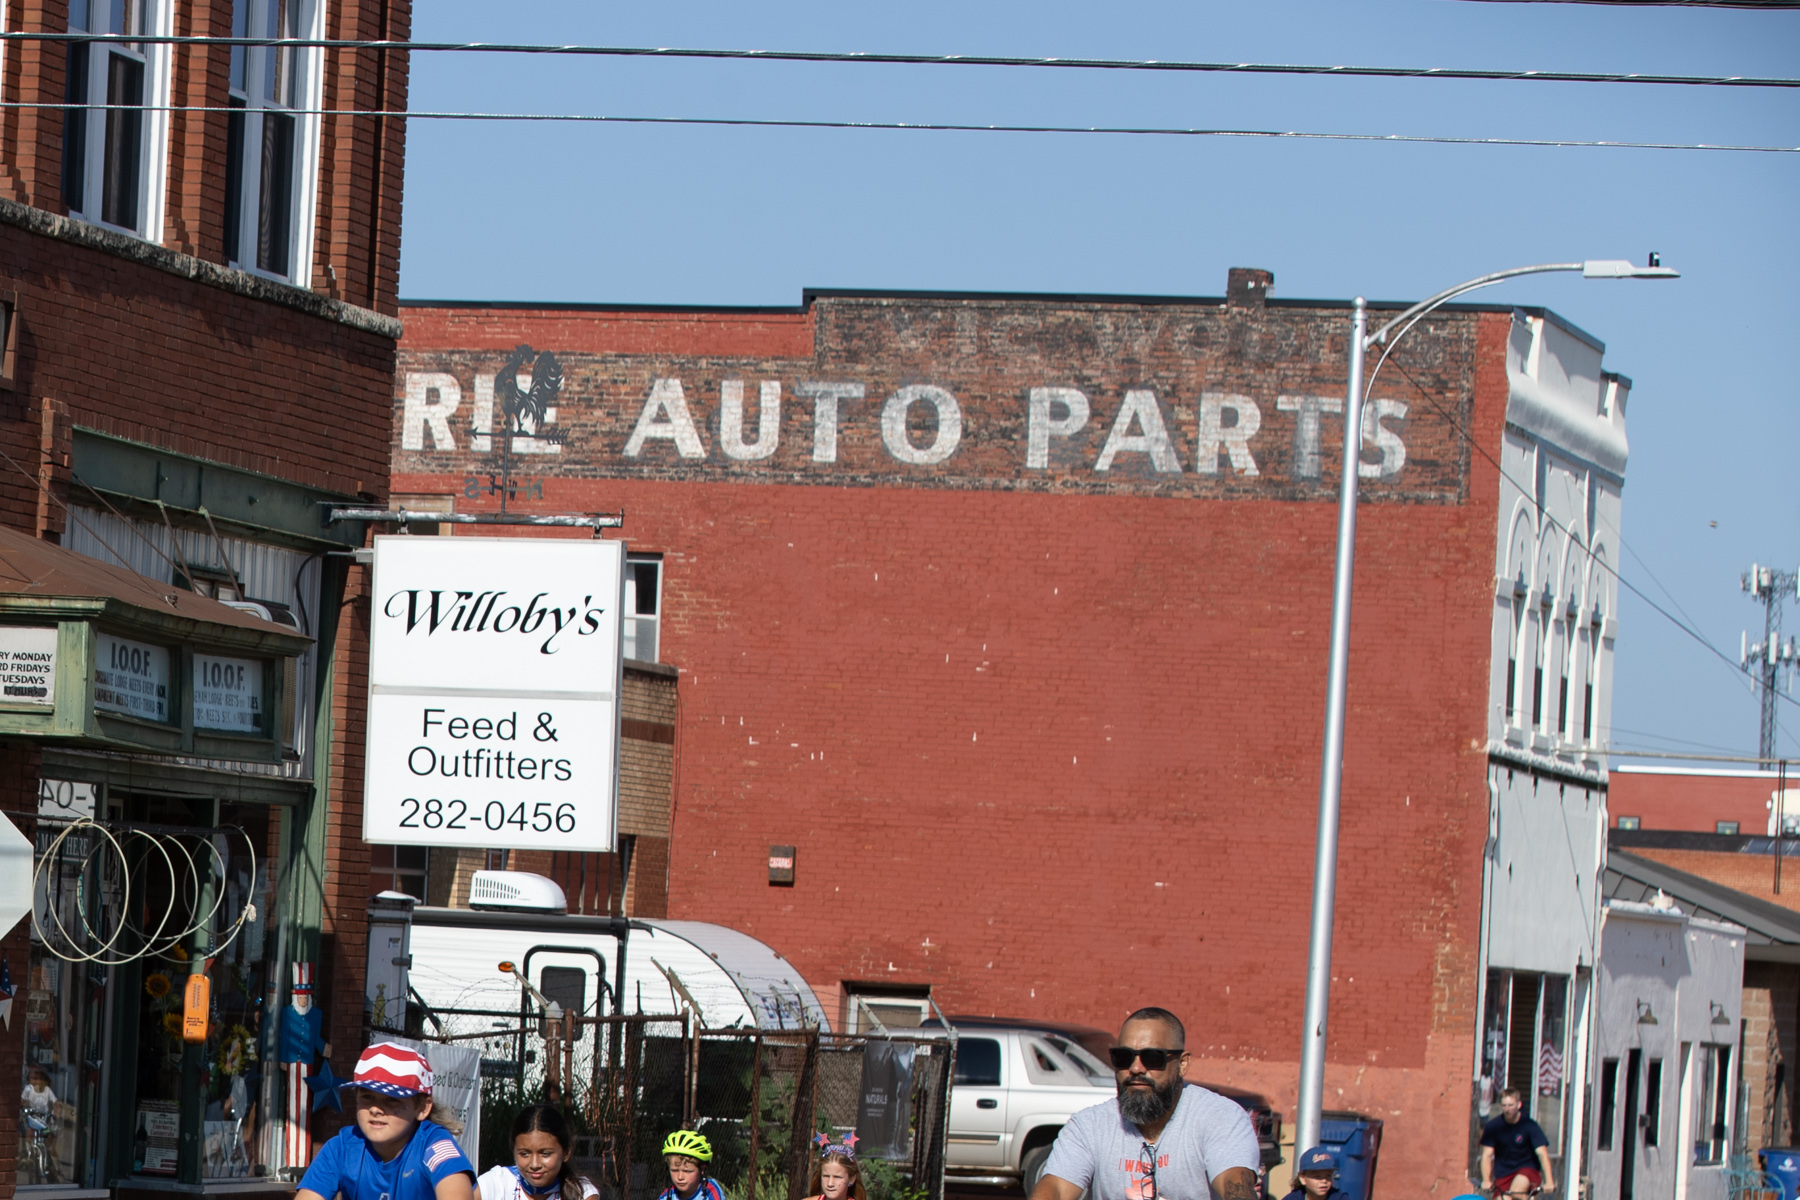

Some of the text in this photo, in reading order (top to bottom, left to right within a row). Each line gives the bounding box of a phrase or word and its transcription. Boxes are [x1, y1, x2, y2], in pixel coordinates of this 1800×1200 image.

[622, 378, 964, 466] AUTO
[1024, 385, 1410, 480] PARTS
[383, 588, 604, 655] Willoby's
[11, 663, 51, 673] FRIDAYS
[12, 653, 53, 662] MONDAY
[111, 642, 151, 677] I.O.O.F.
[203, 661, 245, 691] I.O.O.F.
[422, 707, 559, 742] Feed &
[407, 745, 573, 782] Outfitters
[398, 797, 577, 833] 282-0456
[66, 836, 89, 856] HERE
